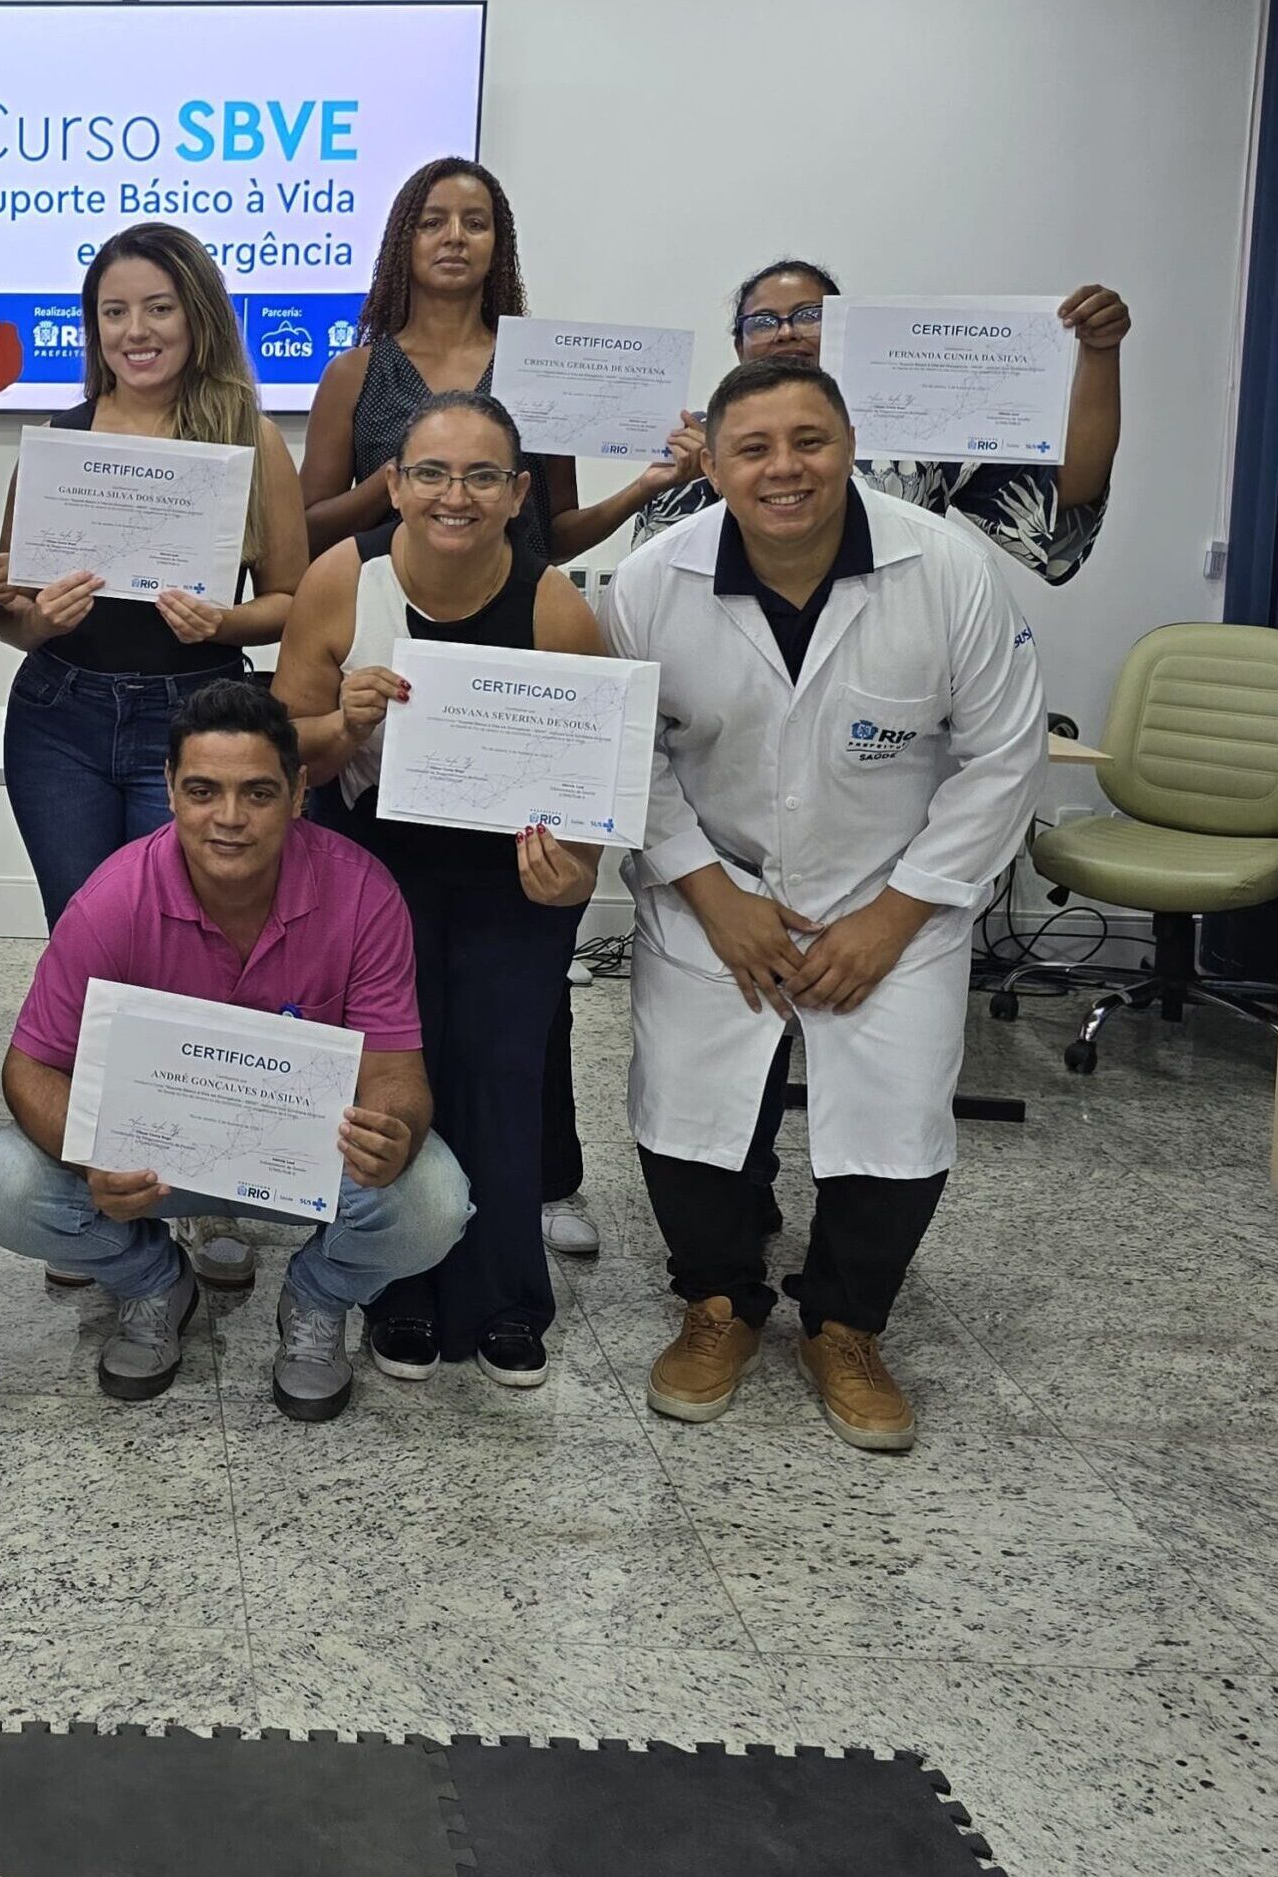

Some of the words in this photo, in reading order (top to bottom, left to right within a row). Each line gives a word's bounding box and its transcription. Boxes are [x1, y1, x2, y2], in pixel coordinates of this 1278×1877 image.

[175, 99, 358, 161] SBVE
[120, 179, 233, 214] Básico
[247, 179, 265, 214] à
[276, 178, 355, 214] Vida
[202, 231, 352, 274] ergência
[34, 306, 83, 319] Realização
[262, 307, 302, 318] Parceria:
[911, 323, 1012, 338] CERTIFICADO
[261, 338, 314, 358] otics
[554, 335, 643, 352] CERTIFICADO
[34, 349, 85, 358] PREFEIT
[888, 350, 941, 360] FERNANDA
[944, 352, 979, 361] CUNHA
[981, 353, 995, 362] DA
[997, 354, 1028, 364] SILVA
[524, 358, 564, 368] CRISTINA
[567, 361, 610, 371] GERALDA
[611, 364, 622, 372] DE
[625, 365, 666, 376] SANTANA
[609, 445, 628, 454] RIO
[977, 440, 998, 450] RIO
[83, 461, 175, 481] CERTIFICADO
[58, 486, 105, 497] GABRIELA
[107, 491, 134, 500] SILVA
[136, 495, 154, 503] DOS
[156, 496, 192, 507] SANTOS
[140, 579, 159, 589] RIO
[471, 678, 577, 702] CERTIFICADO
[441, 705, 489, 718] JOSVANA
[491, 711, 544, 726] SEVERINA
[546, 717, 561, 727] DE
[562, 719, 598, 731] SOUSA
[540, 814, 561, 826] RIO
[181, 1043, 291, 1073] CERTIFICADO
[151, 1069, 190, 1083] ANDRÉ
[191, 1077, 258, 1096] GONÇALVES
[260, 1089, 275, 1100] DA
[277, 1093, 310, 1107] SILVA
[247, 1187, 270, 1200] RIO
